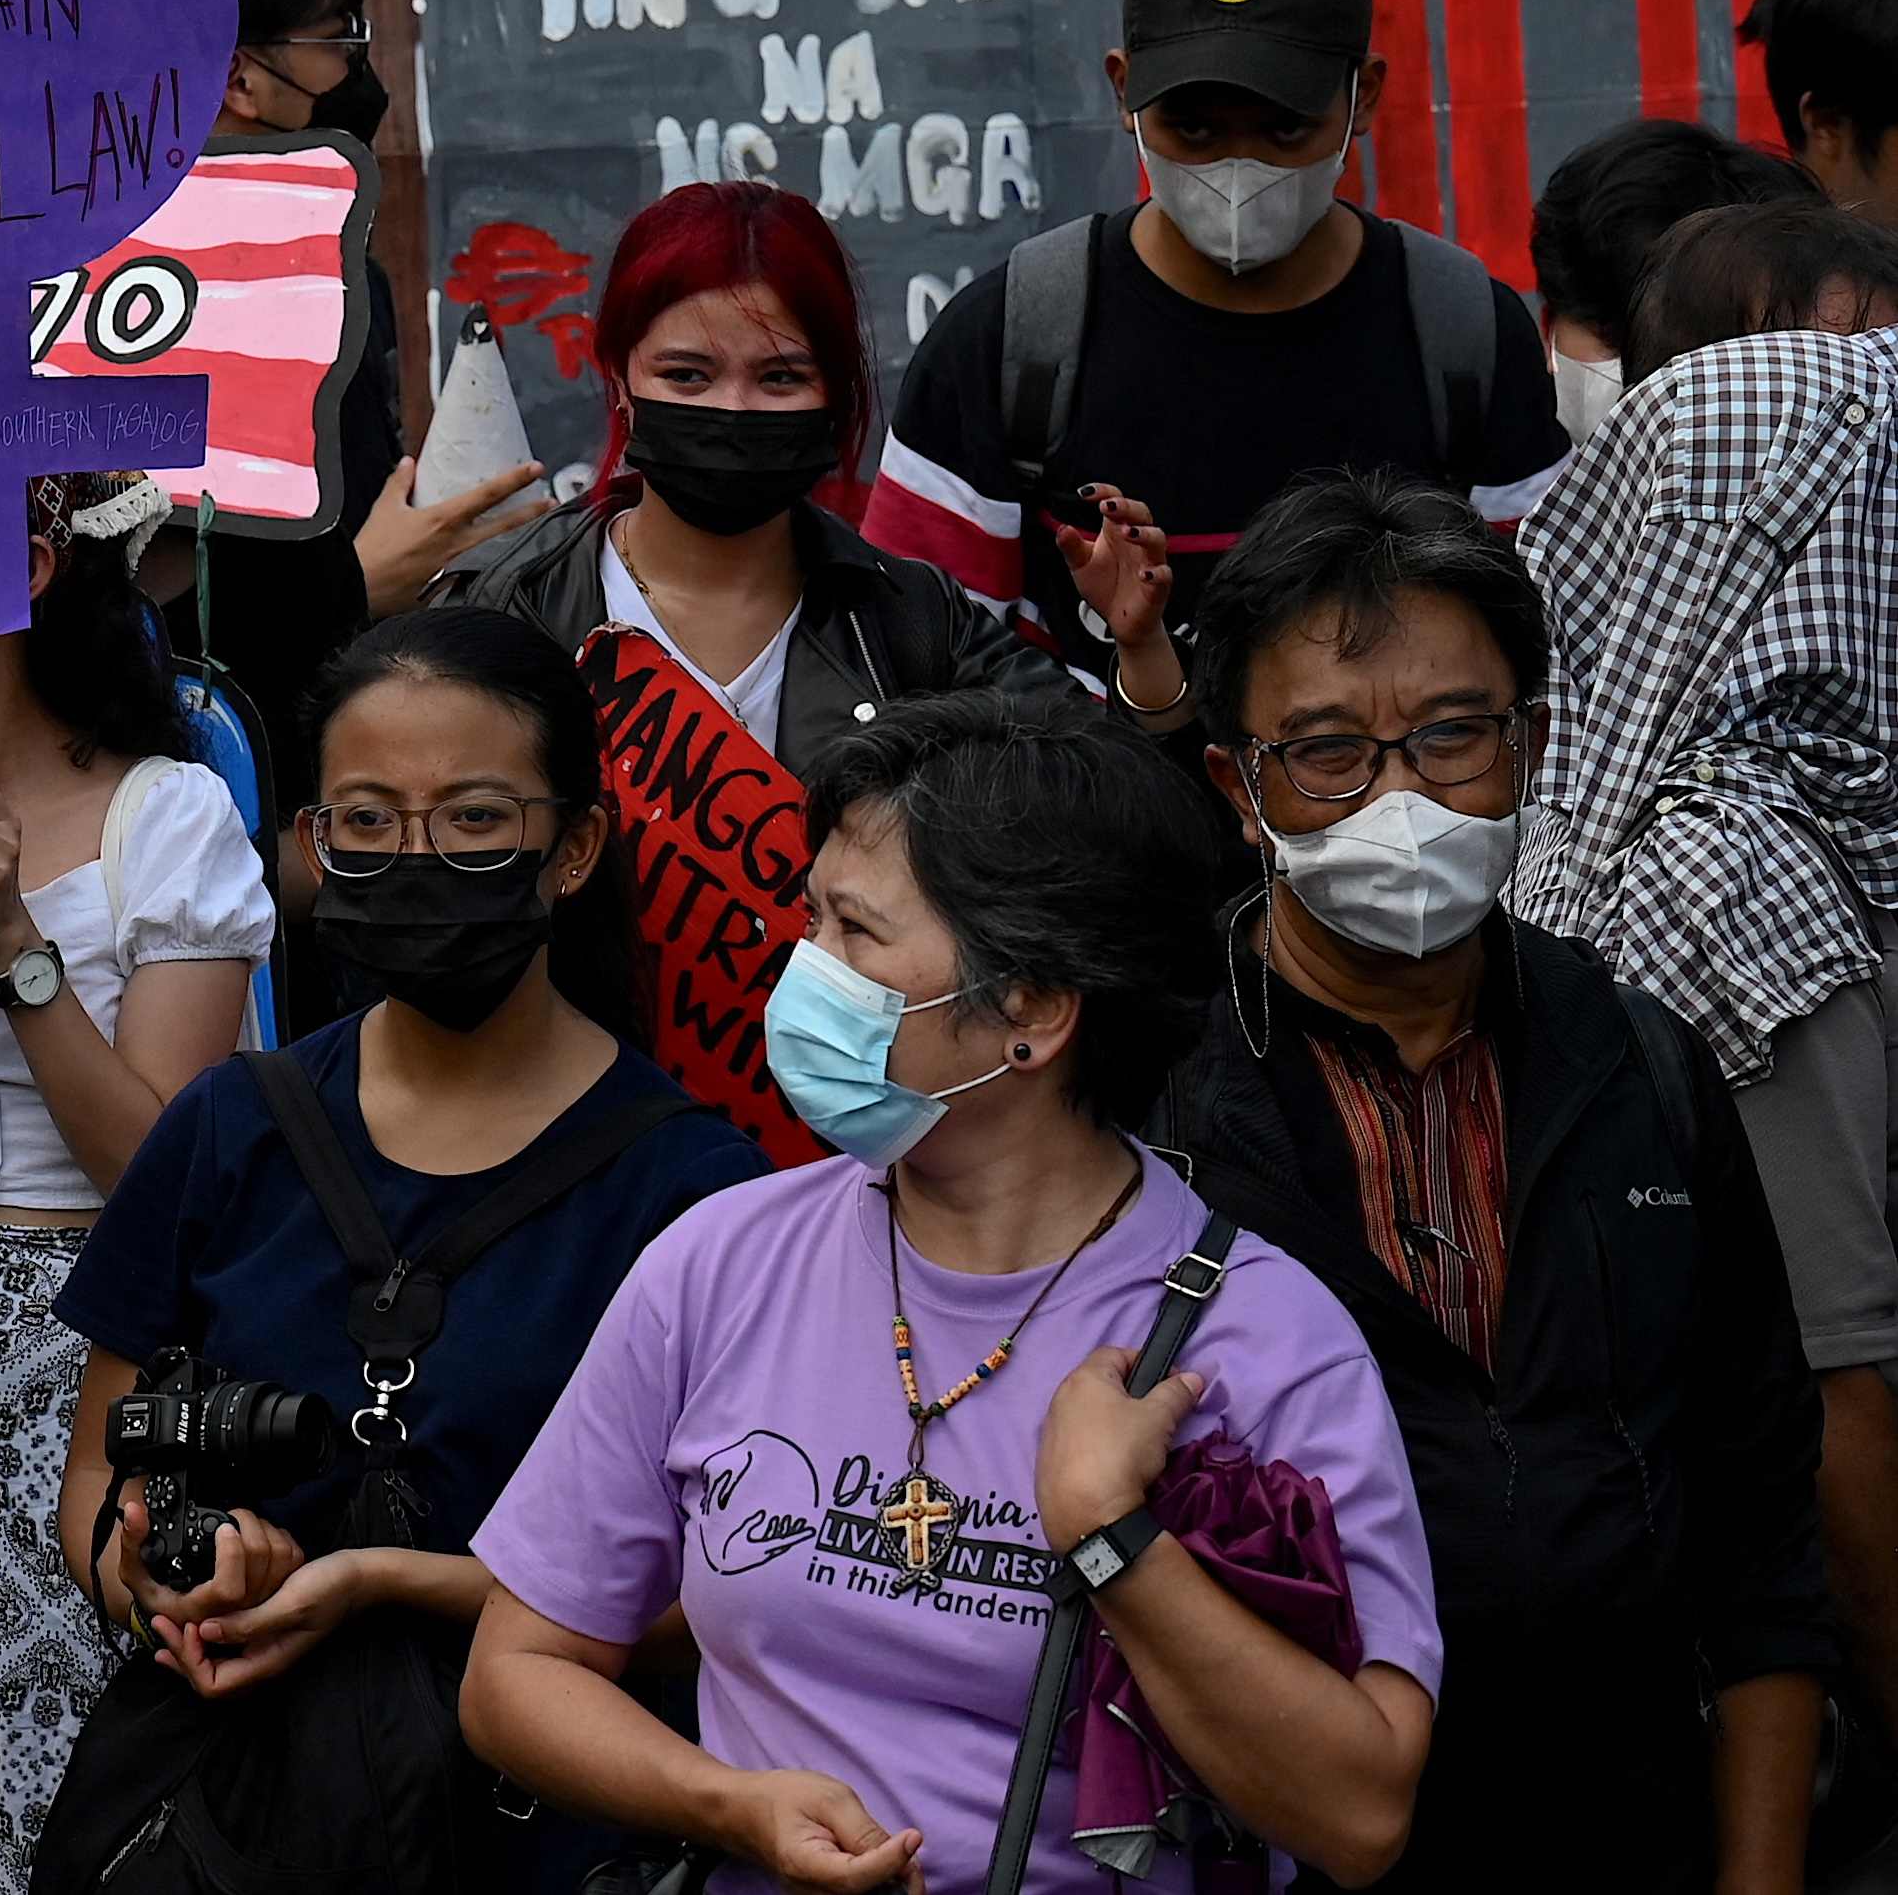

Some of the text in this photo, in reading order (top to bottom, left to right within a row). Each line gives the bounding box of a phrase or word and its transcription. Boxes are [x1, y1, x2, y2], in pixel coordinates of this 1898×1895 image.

[757, 29, 885, 126] NA
[42, 67, 186, 224] LAW!
[818, 111, 1042, 226] MGA
[98, 401, 202, 453] TAGALOG
[576, 634, 816, 908] MANGG
[176, 1402, 190, 1444] Nikon
[805, 1556, 836, 1587] in
[847, 1564, 902, 1601] this
